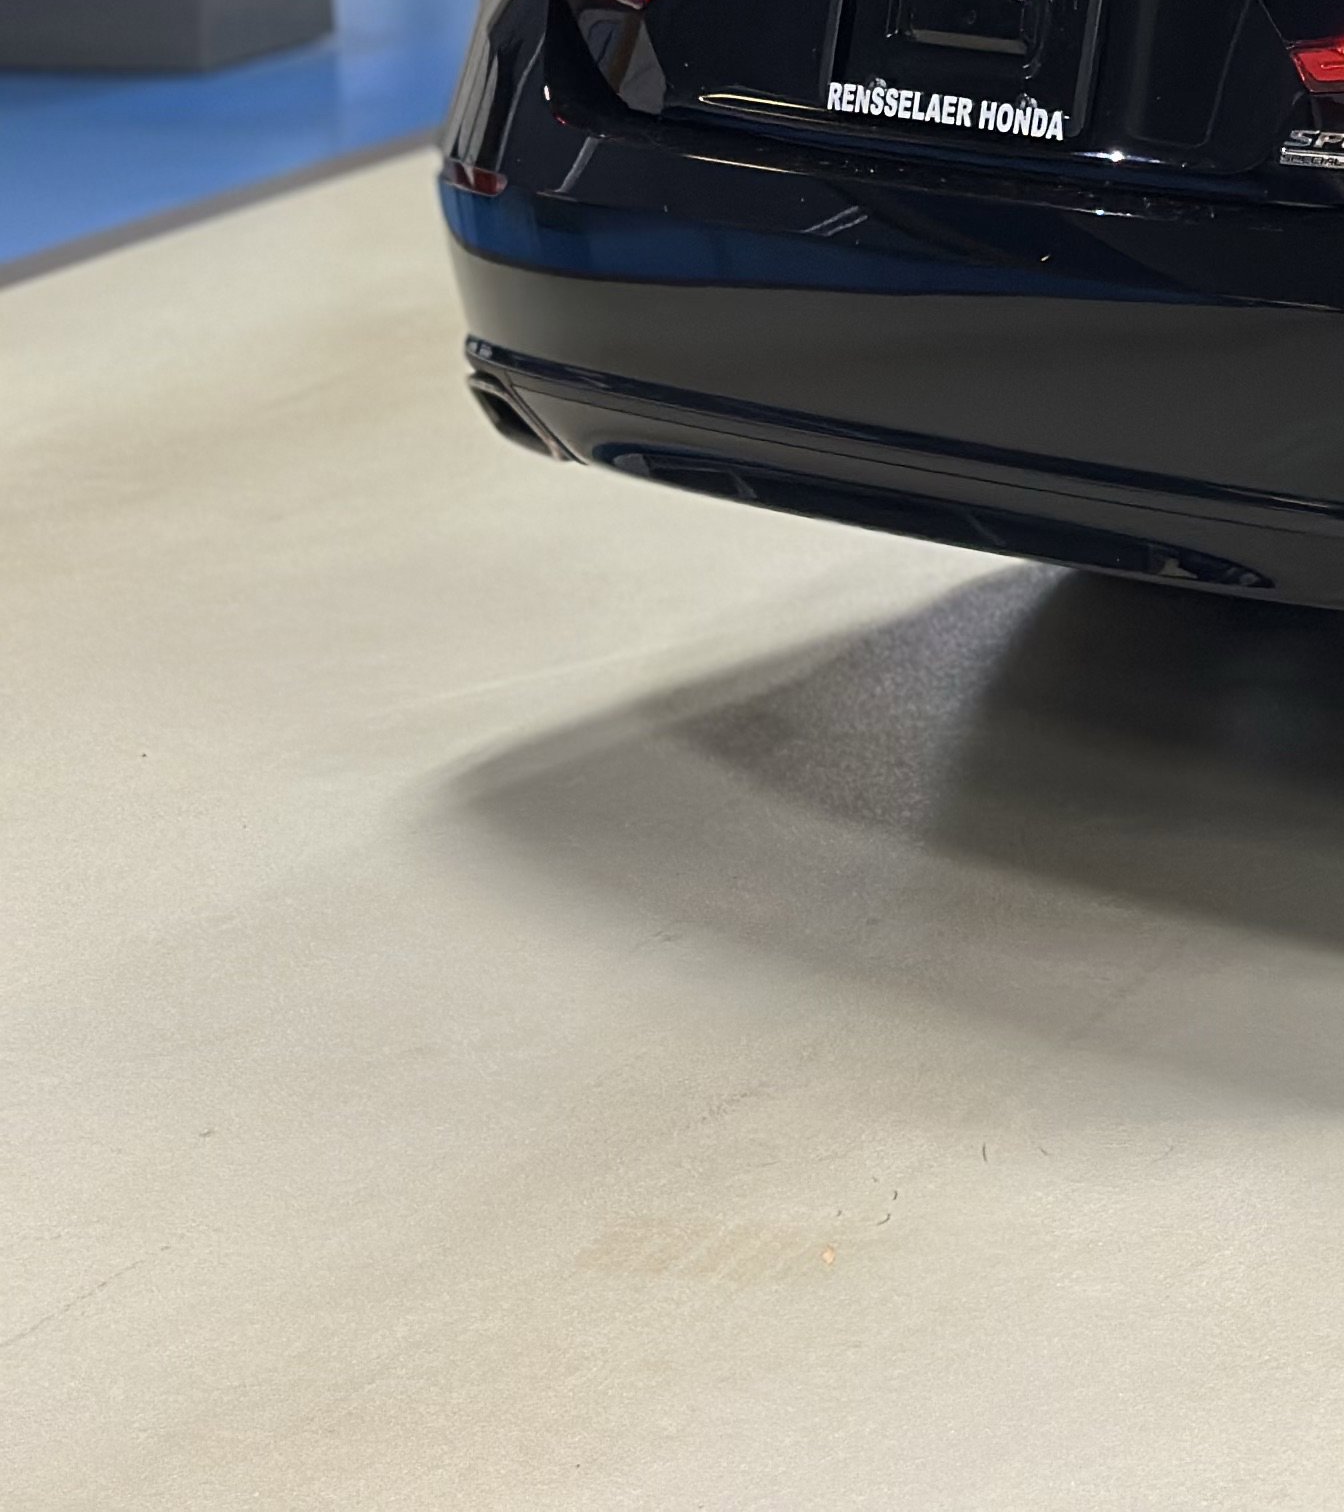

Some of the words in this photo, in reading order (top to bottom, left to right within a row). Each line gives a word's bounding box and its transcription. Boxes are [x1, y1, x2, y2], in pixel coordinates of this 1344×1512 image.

[827, 82, 972, 127] RENSSELAER
[978, 100, 1064, 140] HONDA
[1280, 153, 1343, 168] SPECIAL
